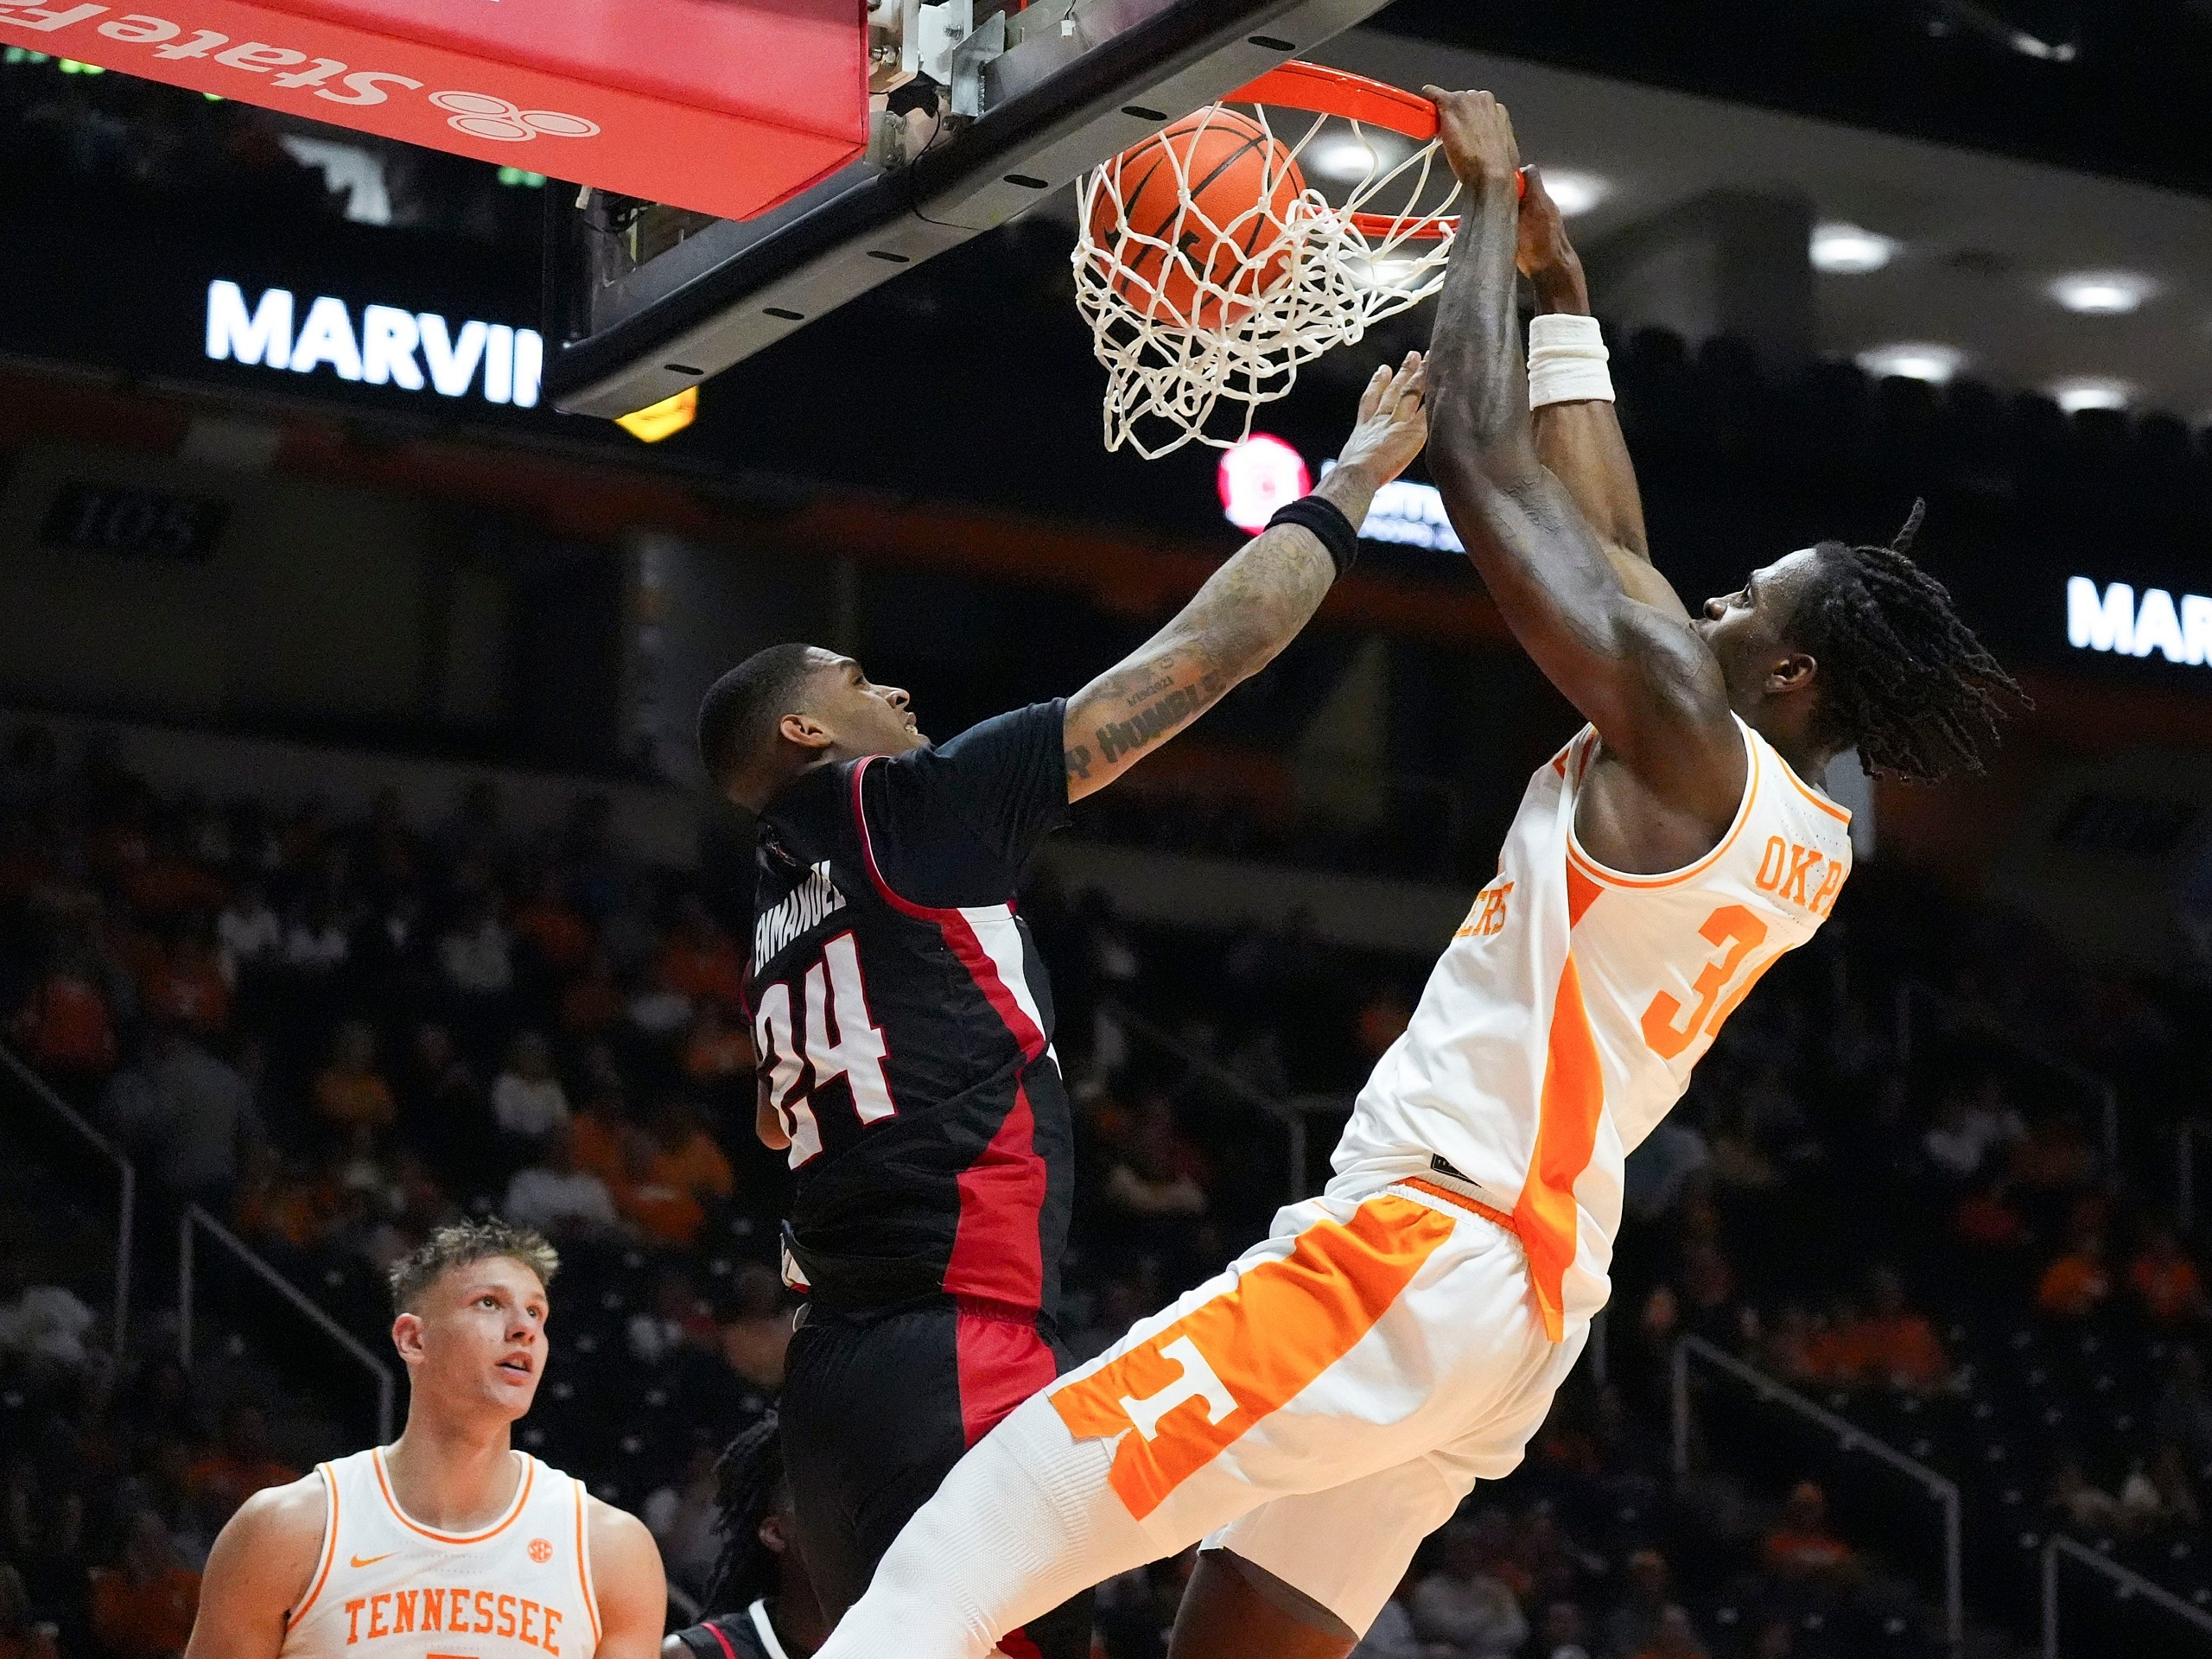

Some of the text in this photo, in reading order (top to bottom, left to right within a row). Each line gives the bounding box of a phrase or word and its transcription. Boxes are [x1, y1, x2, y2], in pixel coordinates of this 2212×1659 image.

[0, 0, 423, 105] State F
[753, 931, 896, 1171] 24
[1117, 1334, 1239, 1443] T
[345, 1588, 563, 1657] TENNESSEE
